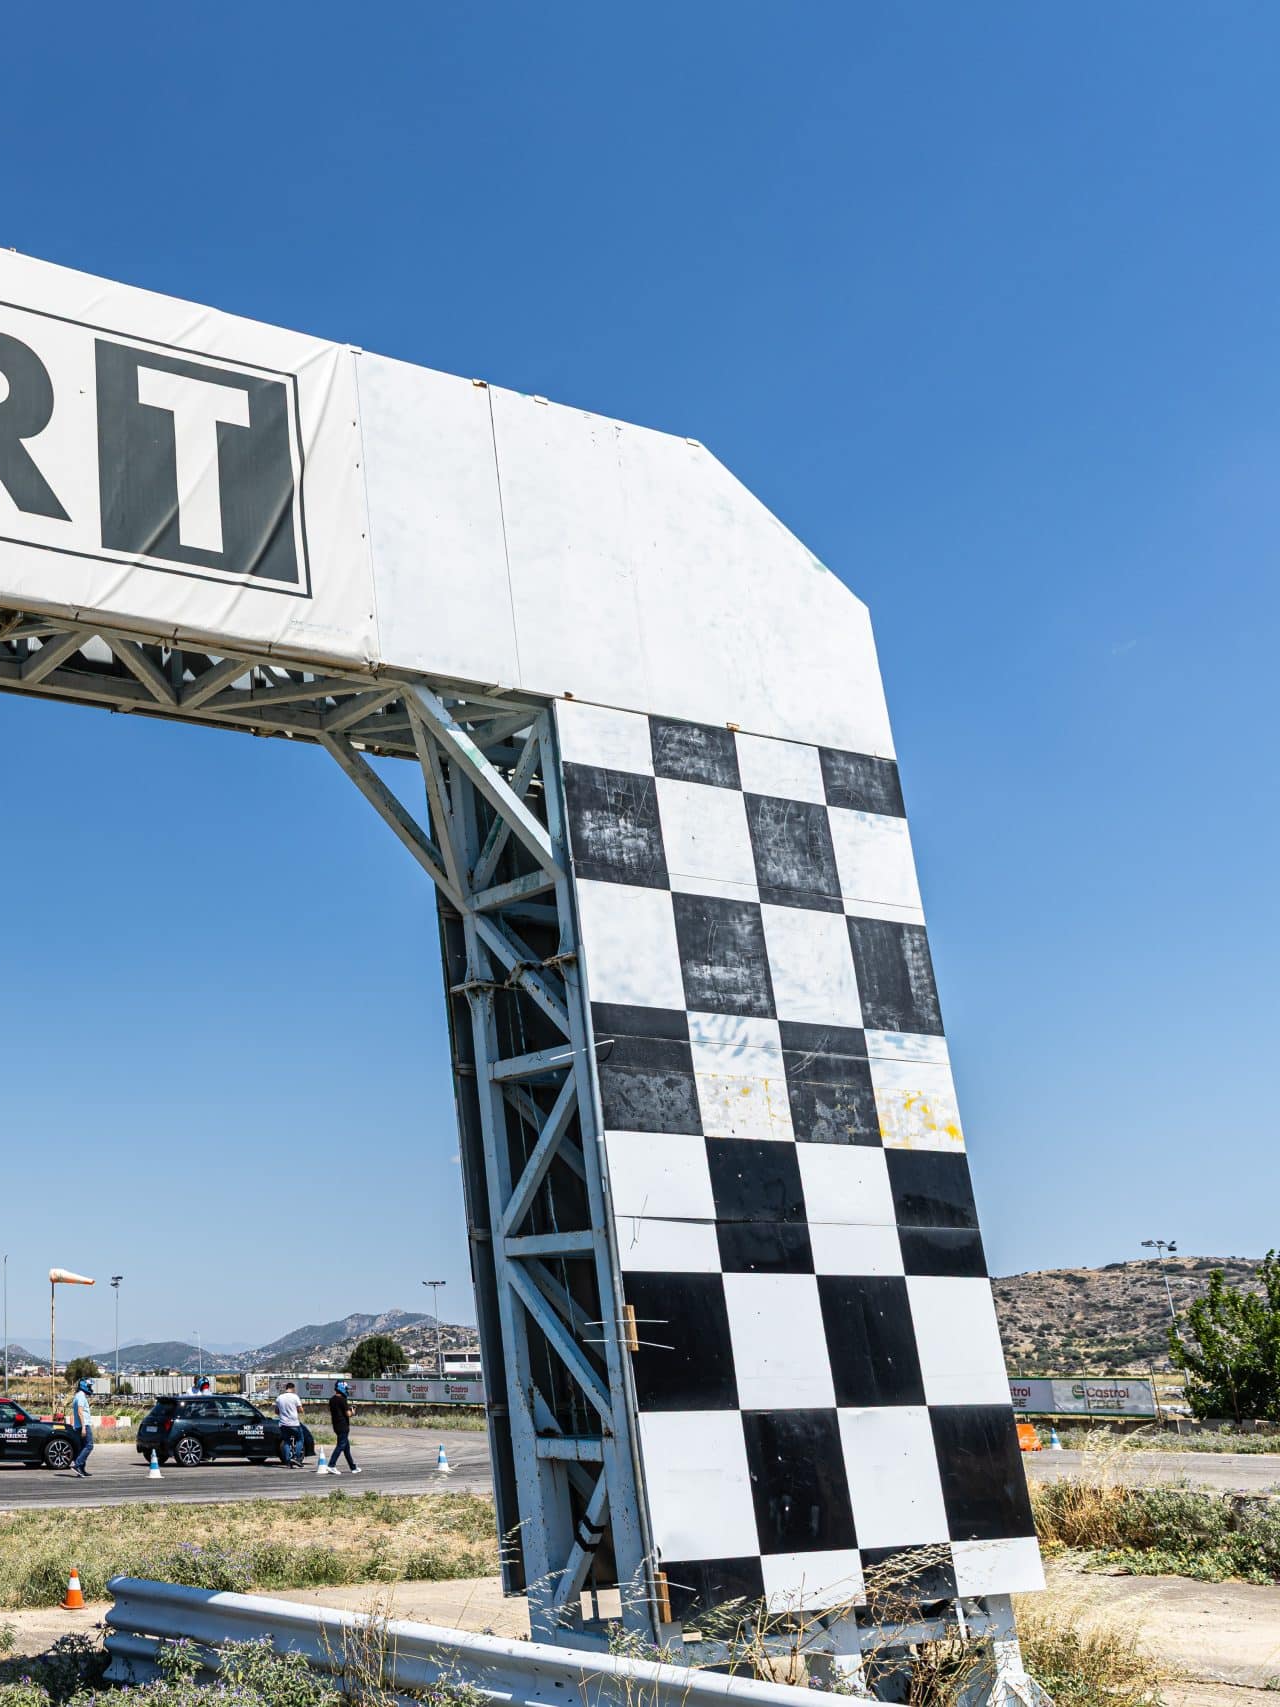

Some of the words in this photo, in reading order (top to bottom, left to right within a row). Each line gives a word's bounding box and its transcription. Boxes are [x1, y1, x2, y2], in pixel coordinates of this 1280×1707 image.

[1010, 1386, 1031, 1397] trol
[1086, 1387, 1130, 1399] Castrol
[1012, 1398, 1027, 1408] GE
